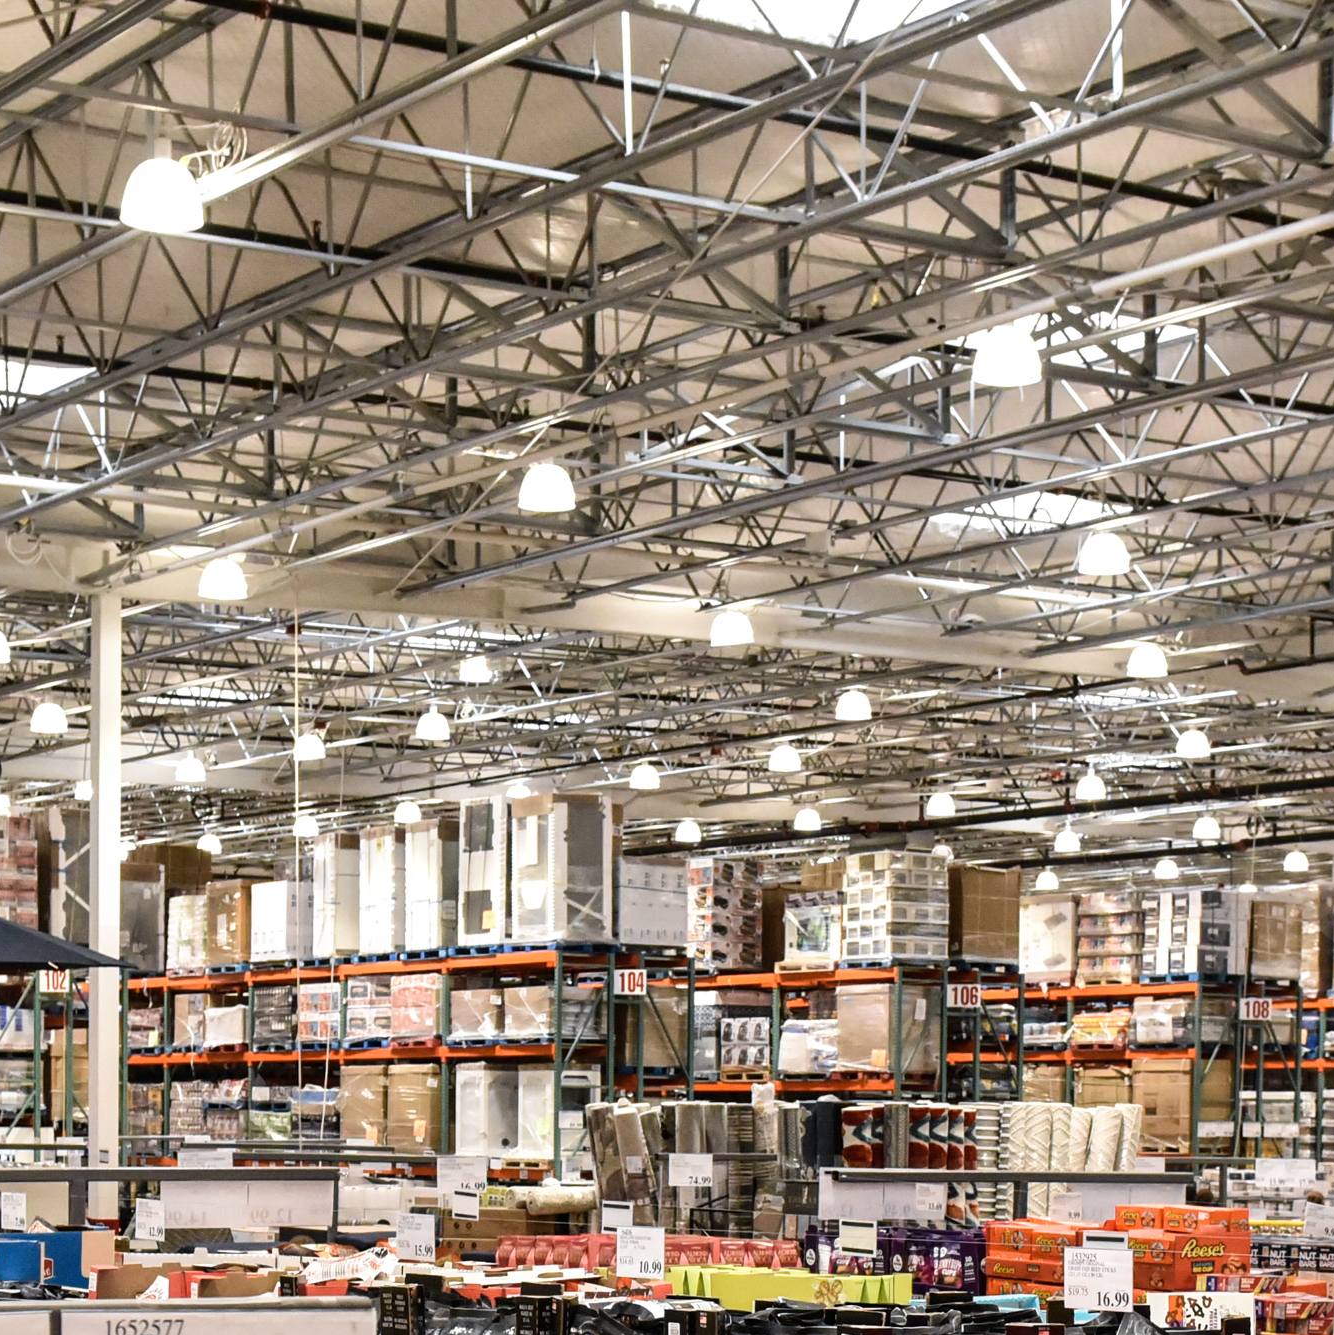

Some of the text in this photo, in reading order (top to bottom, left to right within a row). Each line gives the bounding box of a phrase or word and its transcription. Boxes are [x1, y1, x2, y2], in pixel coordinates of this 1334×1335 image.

[43, 971, 67, 991] 102
[618, 972, 645, 994] 104
[949, 986, 979, 1006] 106
[1243, 1000, 1268, 1018] 108
[687, 1176, 711, 1186] 74.99
[414, 1243, 435, 1258] 15.99
[1181, 1239, 1225, 1259] Reese's
[638, 1261, 663, 1276] 10.99
[1096, 1291, 1129, 1307] 16.99
